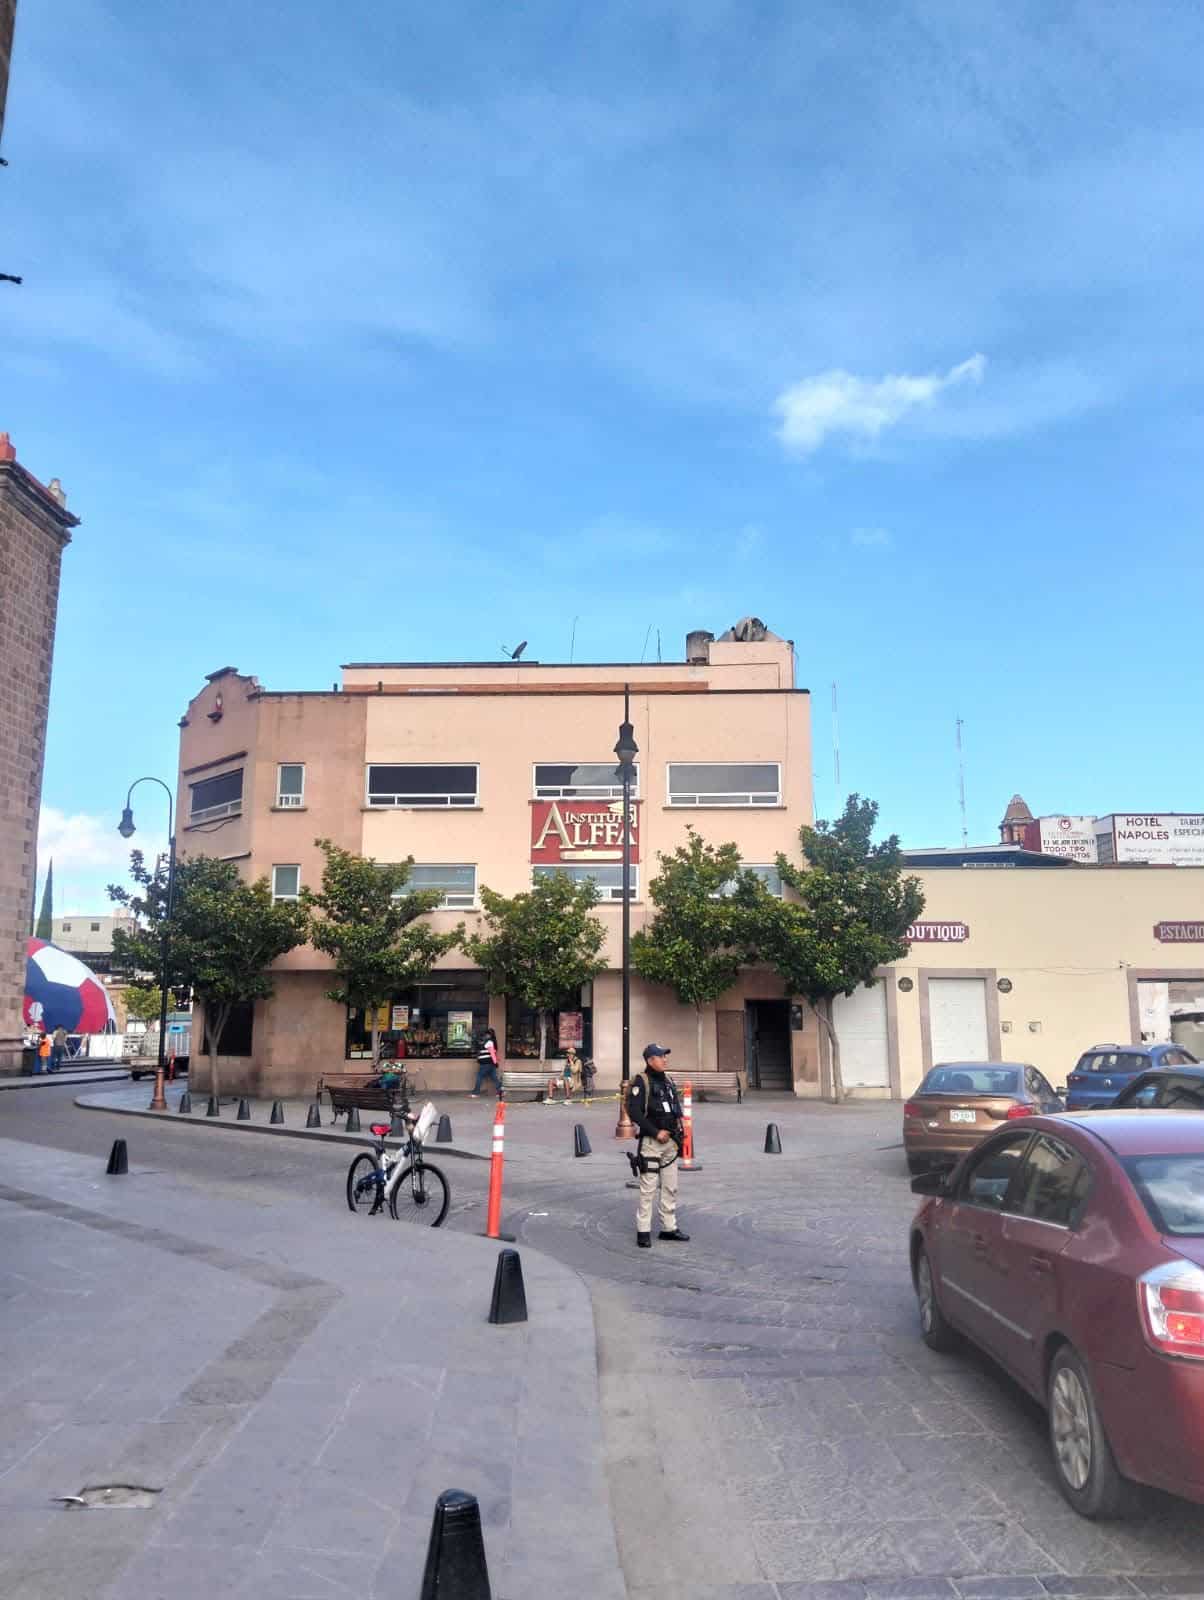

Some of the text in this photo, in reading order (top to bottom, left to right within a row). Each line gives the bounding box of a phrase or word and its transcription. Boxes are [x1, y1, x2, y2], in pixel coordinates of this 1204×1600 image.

[532, 801, 637, 849] ALFFA
[1126, 817, 1162, 827] HOTEL
[1118, 831, 1169, 840] NAPOLES
[905, 925, 965, 941] OUTIQUE
